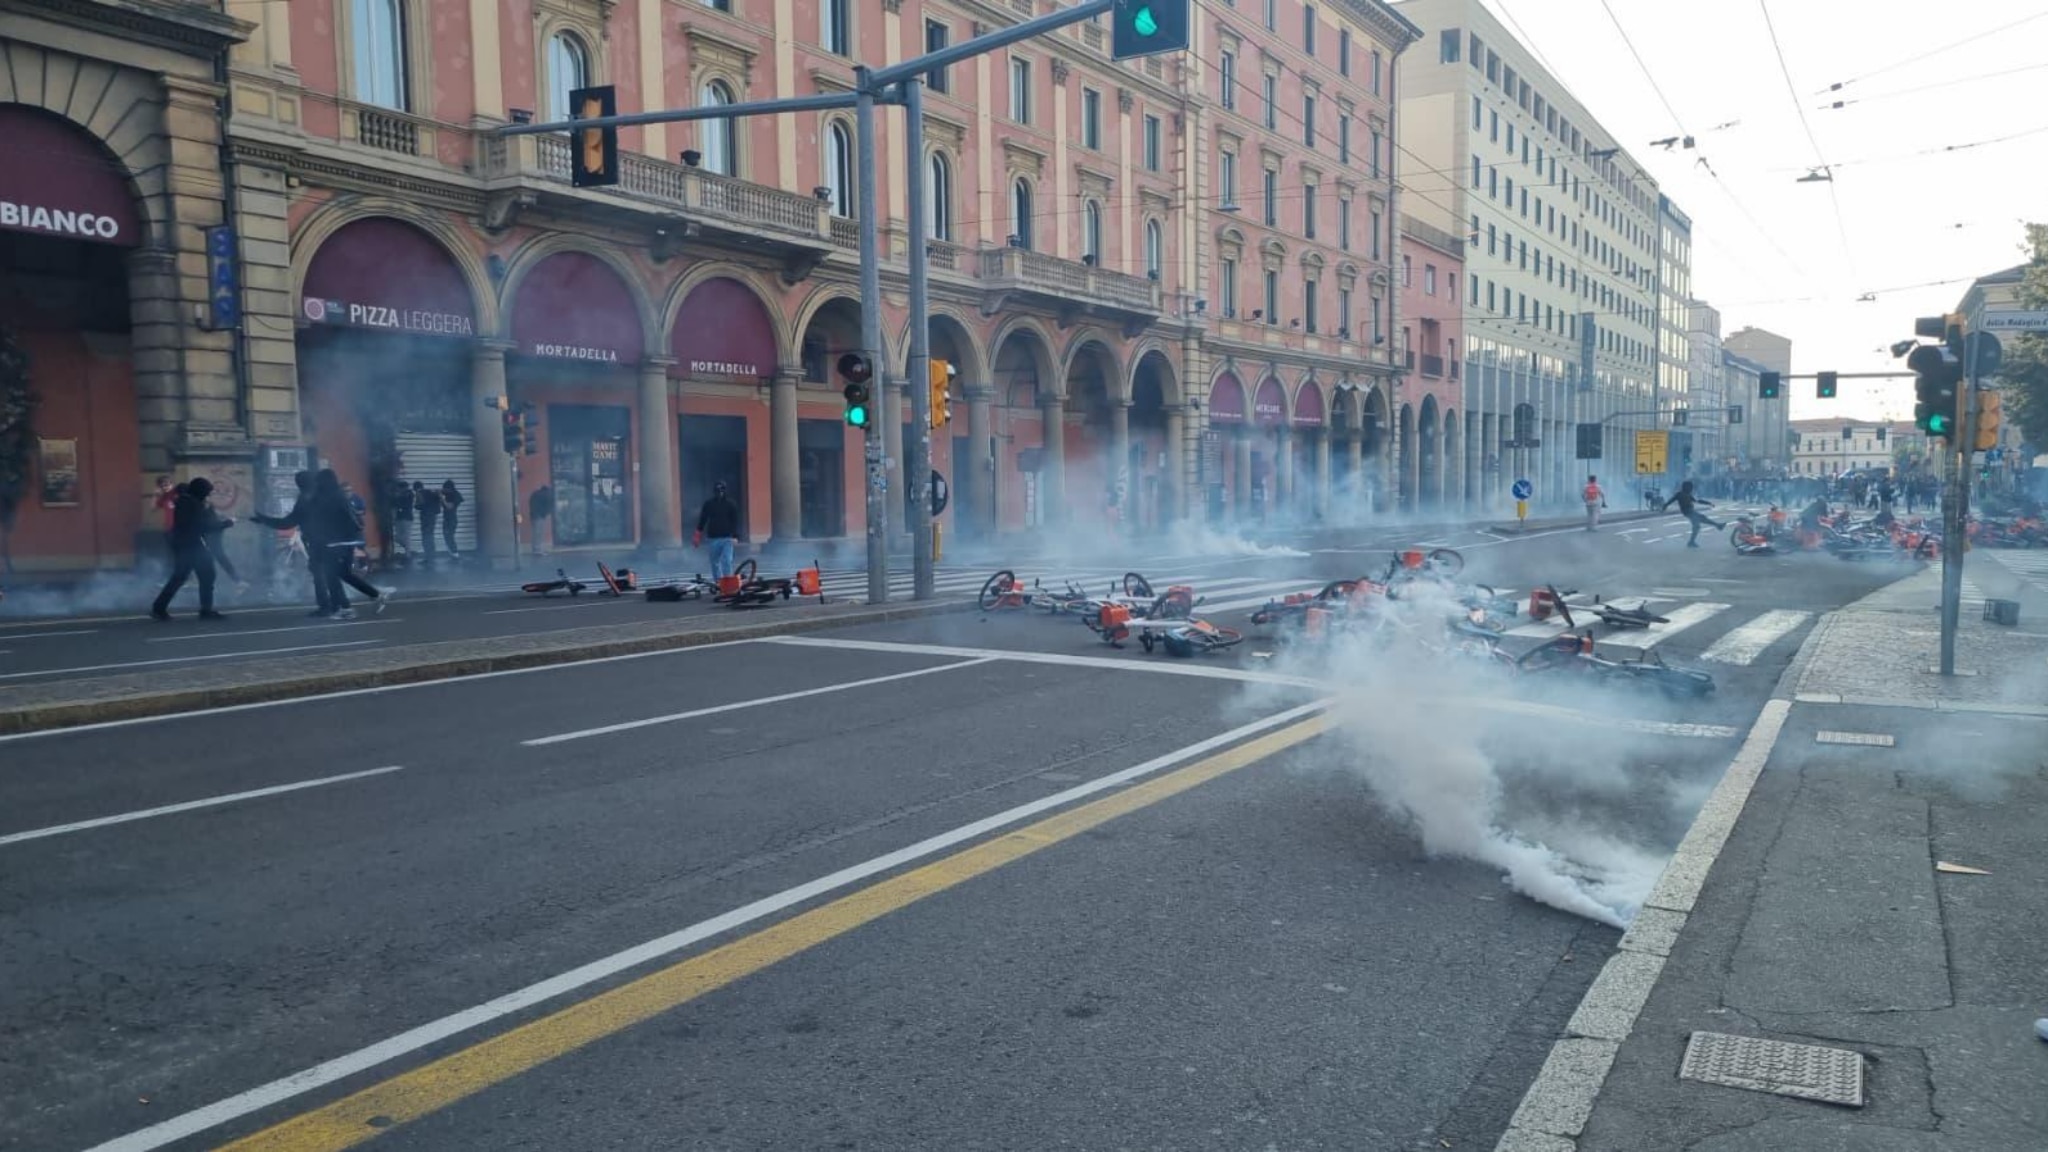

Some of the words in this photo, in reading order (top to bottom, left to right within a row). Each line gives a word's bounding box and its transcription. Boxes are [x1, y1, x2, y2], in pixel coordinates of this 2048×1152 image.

[0, 201, 118, 238] BIANCO
[350, 304, 399, 328] PIZZA
[404, 310, 472, 335] LEGGERA
[536, 344, 617, 361] MORTADELLA
[691, 360, 757, 375] MORTADELLA
